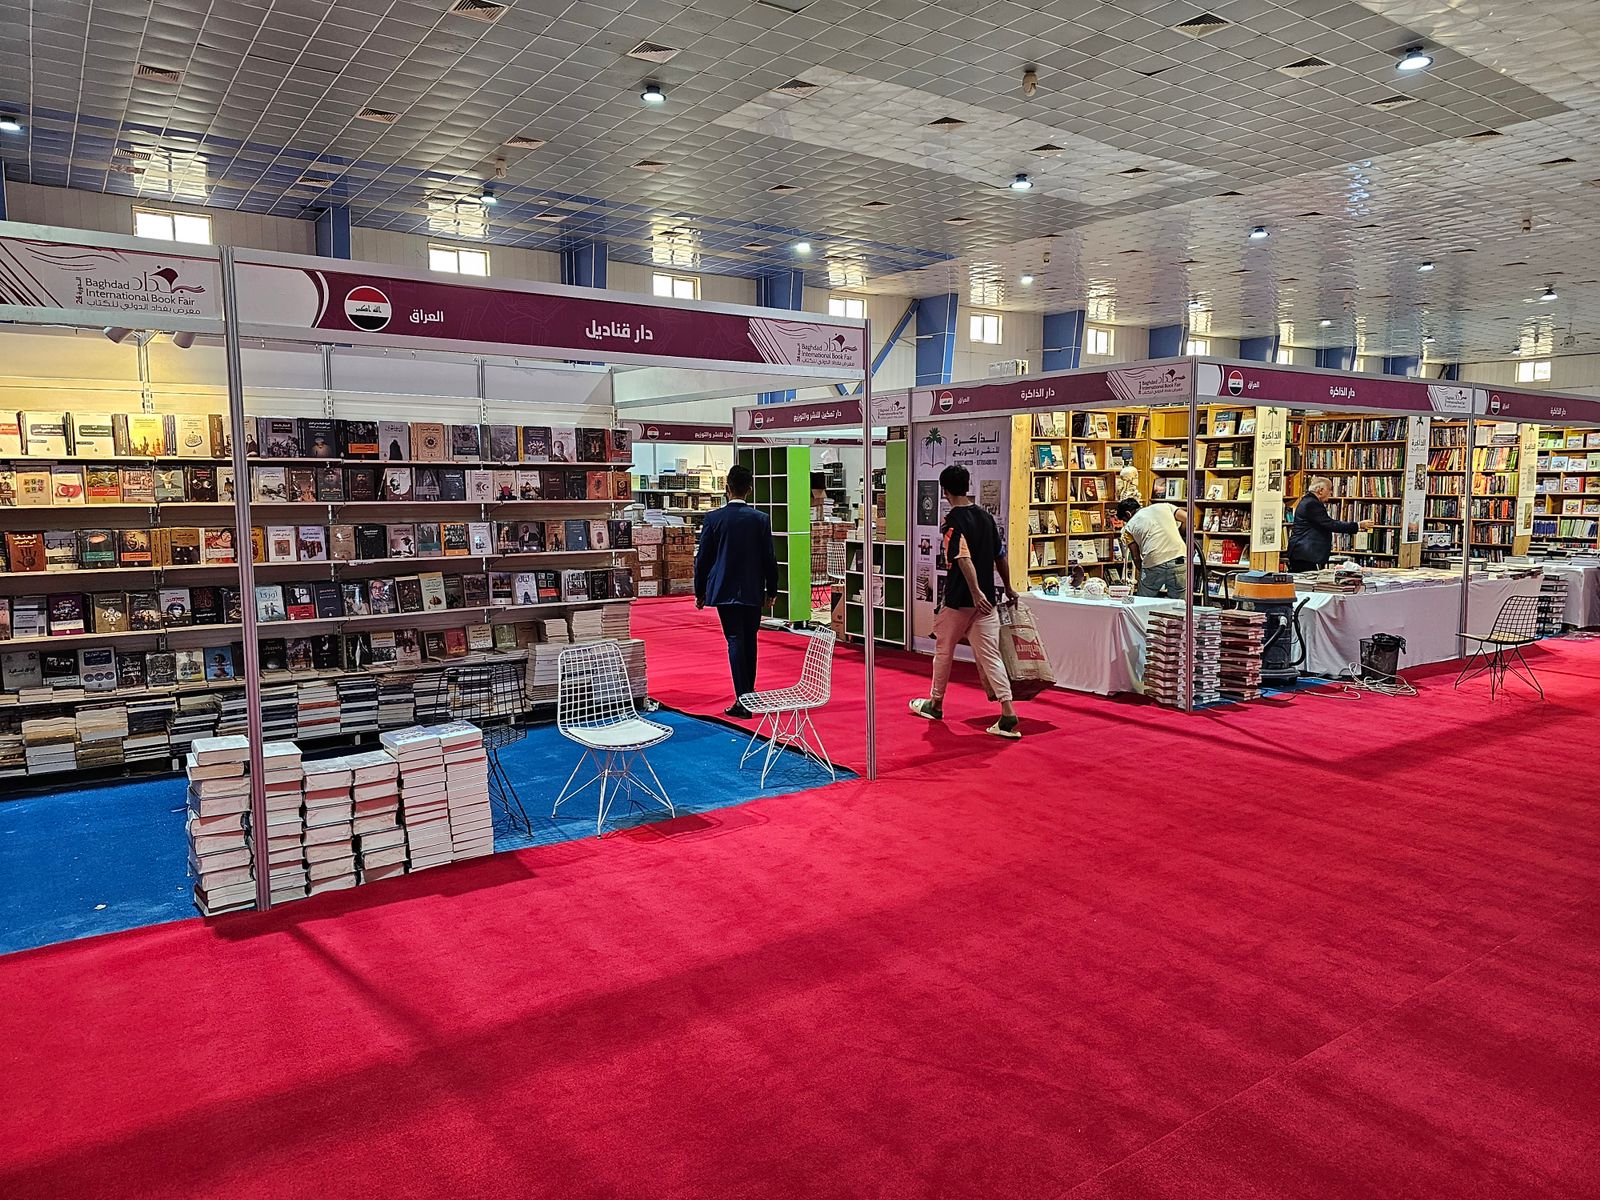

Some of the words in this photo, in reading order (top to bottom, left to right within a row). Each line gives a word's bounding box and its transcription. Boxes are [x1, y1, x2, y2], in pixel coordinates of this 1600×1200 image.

[85, 277, 130, 290] Baghdad
[86, 288, 149, 303] International
[151, 294, 175, 305] Book
[178, 296, 195, 307] Fair
[87, 300, 119, 309] للكتاب
[120, 302, 149, 311] الدولي
[151, 304, 172, 313] بغداد
[172, 306, 201, 315] معرض
[409, 308, 444, 324] العراق
[585, 319, 631, 340] قناديل
[634, 324, 654, 343] دار
[801, 343, 823, 352] Baghdad
[801, 350, 831, 359] International
[831, 352, 843, 360] Book
[1247, 381, 1260, 390] العراق
[1020, 388, 1044, 401] الذاكرة
[1045, 387, 1055, 399] دار
[1329, 386, 1348, 398] الذاكرة
[1347, 387, 1355, 399] دار
[793, 412, 810, 422] والتوزيع
[809, 411, 821, 421] للنشر
[694, 431, 712, 439] والتوزيع
[712, 431, 723, 439] للنشر
[953, 430, 1000, 447] الذاكرة
[1261, 430, 1282, 440] الذاكرة
[952, 447, 980, 457] والتوزيع
[980, 446, 1000, 456] للنشر
